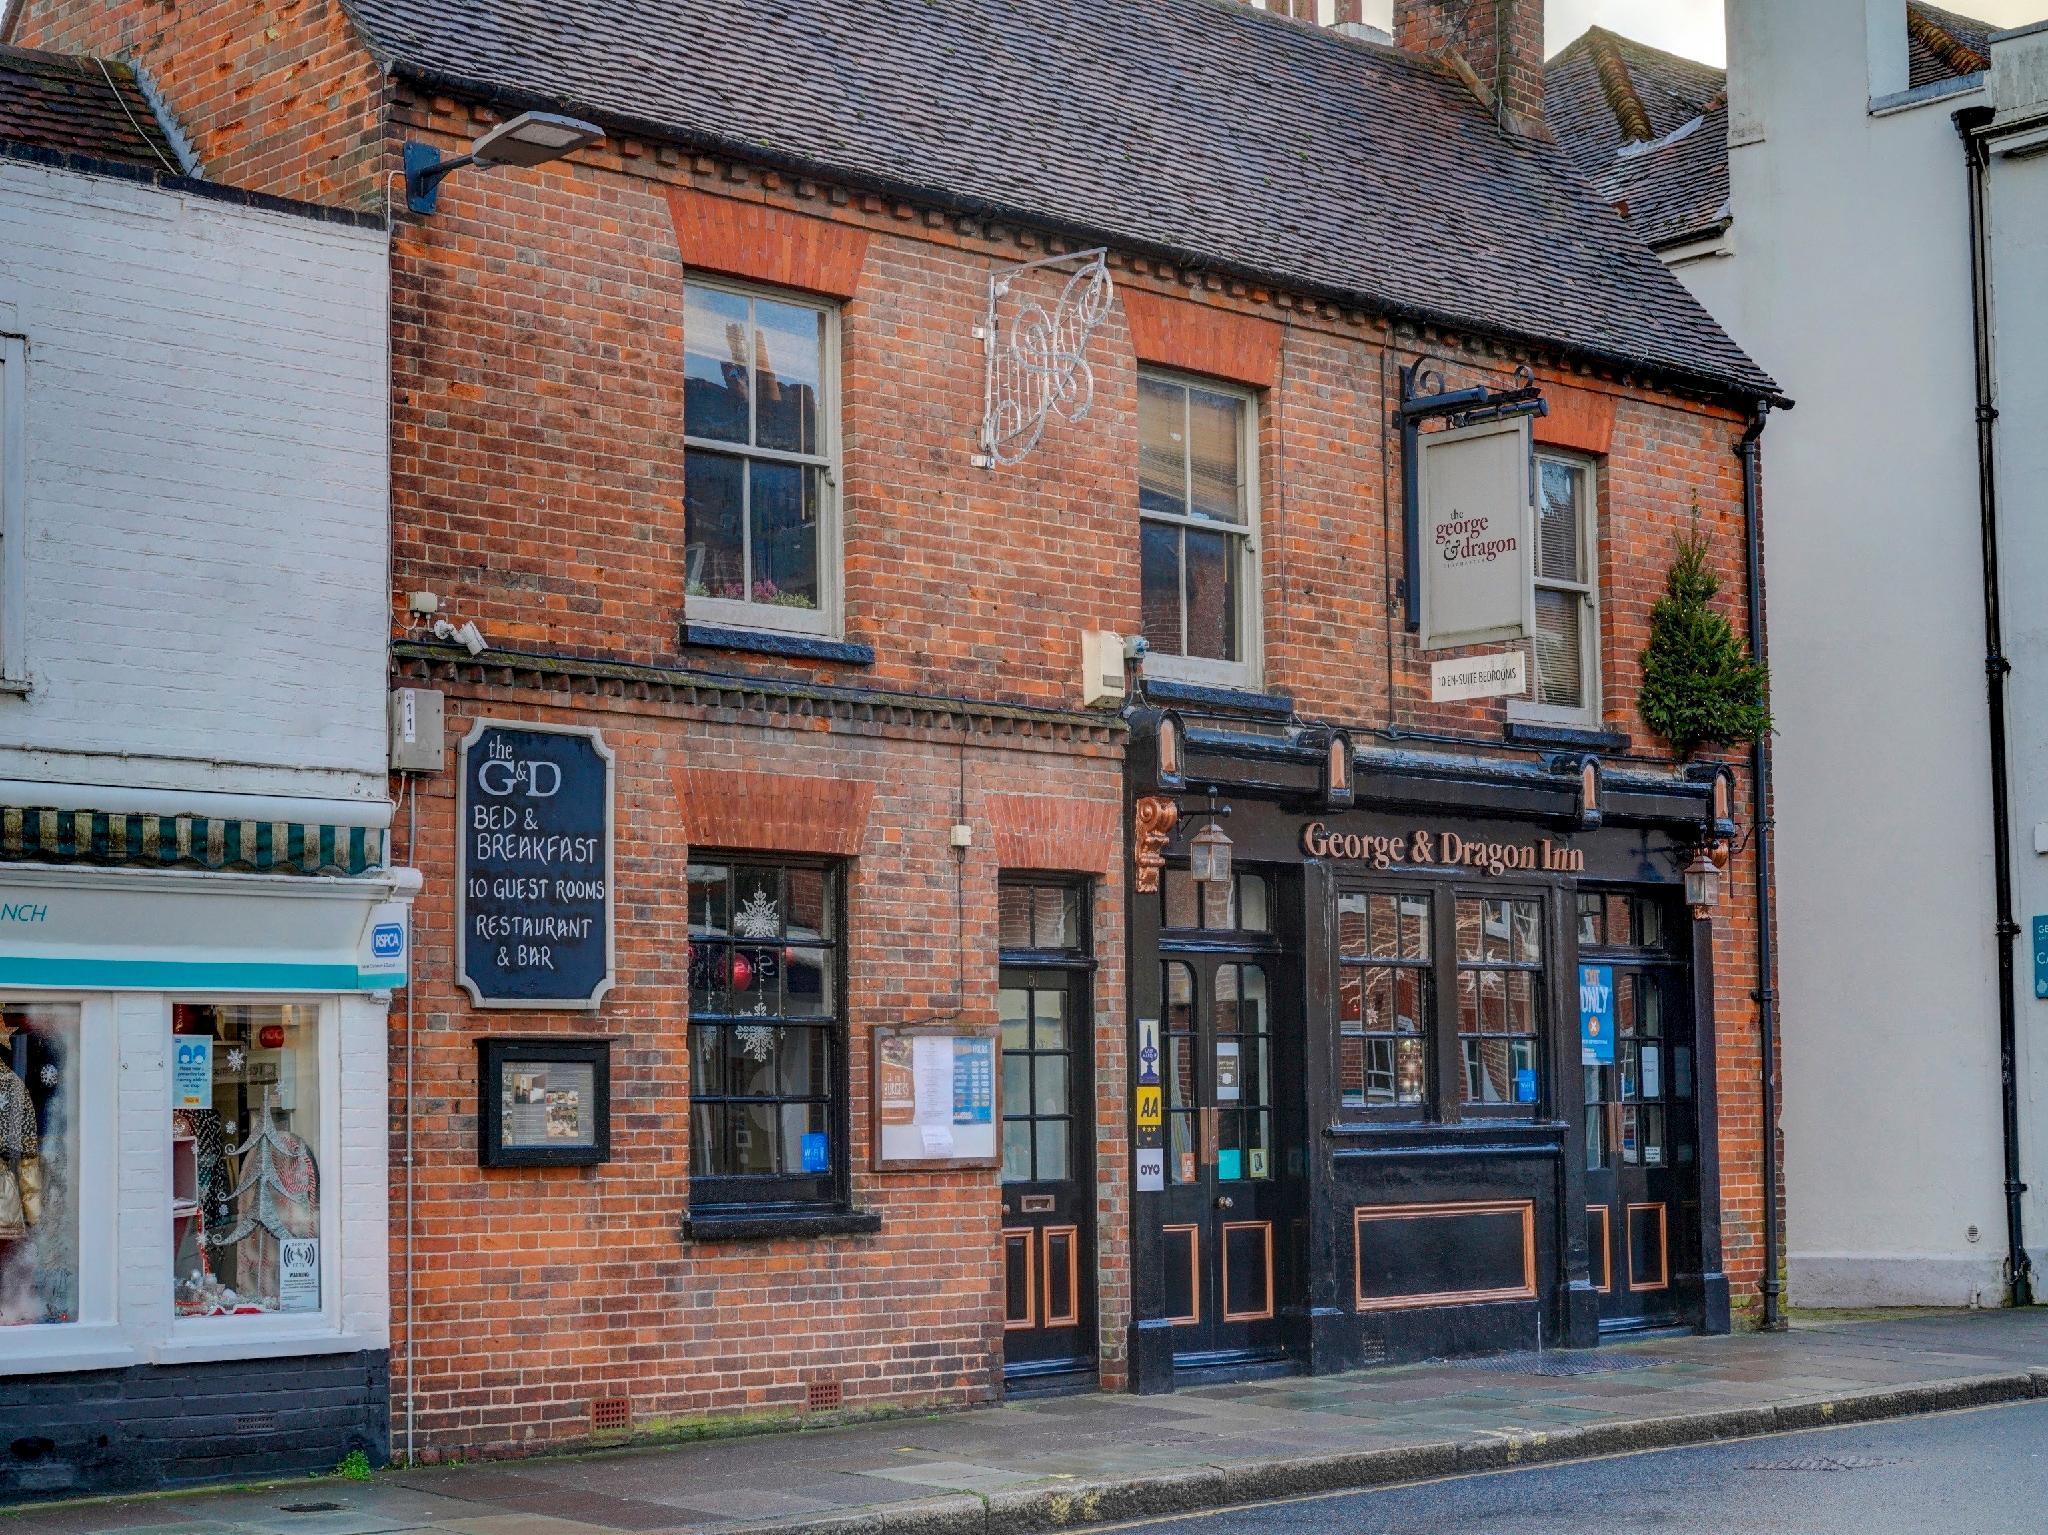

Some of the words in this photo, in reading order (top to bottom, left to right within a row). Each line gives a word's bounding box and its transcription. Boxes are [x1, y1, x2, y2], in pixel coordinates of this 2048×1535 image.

[1450, 509, 1464, 520] the
[1436, 517, 1489, 545] george
[1443, 539, 1460, 560] &
[1461, 536, 1516, 561] dragon
[1478, 667, 1516, 683] BEDROOMS
[488, 735, 512, 759] the
[474, 805, 517, 829] BED
[524, 808, 539, 830] &
[477, 833, 598, 865] BREAKFAST
[1304, 822, 1404, 869] George
[1412, 830, 1433, 863] &
[1440, 832, 1535, 875] Dragon
[1541, 839, 1585, 871] Inn
[469, 878, 488, 898] 10
[493, 878, 549, 900] GUEST
[556, 880, 604, 904] ROOMS
[1, 903, 48, 922] NCH
[375, 932, 400, 948] RSPCA
[476, 914, 592, 941] RESTAURANT
[497, 946, 510, 966] &
[518, 944, 554, 970] BAR
[1580, 986, 1608, 1013] ONLY
[1141, 1097, 1159, 1117] AA
[1140, 1164, 1160, 1175] OYO
